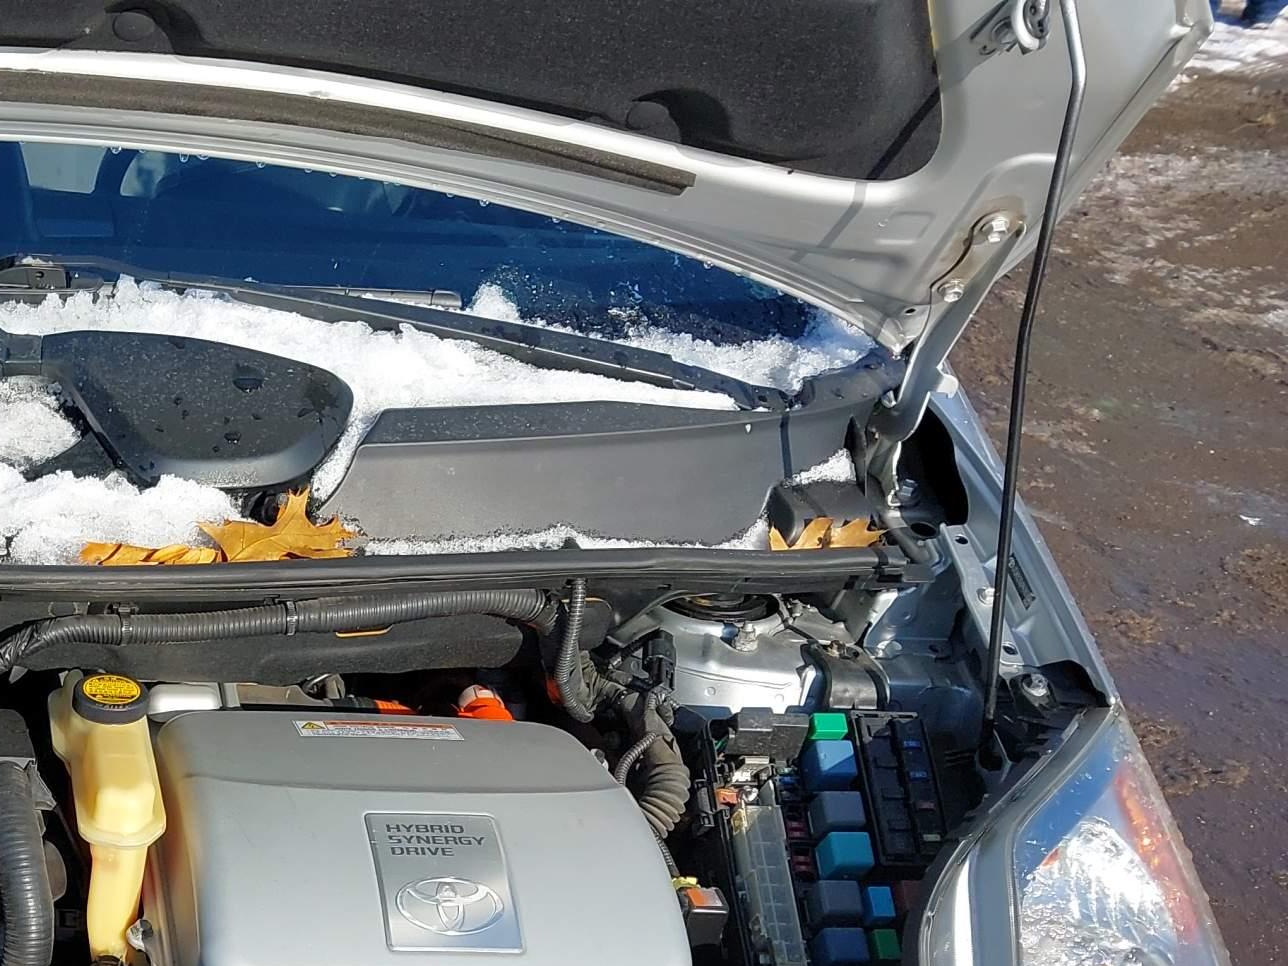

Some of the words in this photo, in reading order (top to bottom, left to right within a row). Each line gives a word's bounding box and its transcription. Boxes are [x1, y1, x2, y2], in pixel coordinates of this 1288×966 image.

[385, 823, 465, 834] HYBRID
[387, 834, 485, 846] SYNERGY
[390, 846, 455, 857] DRIVE
